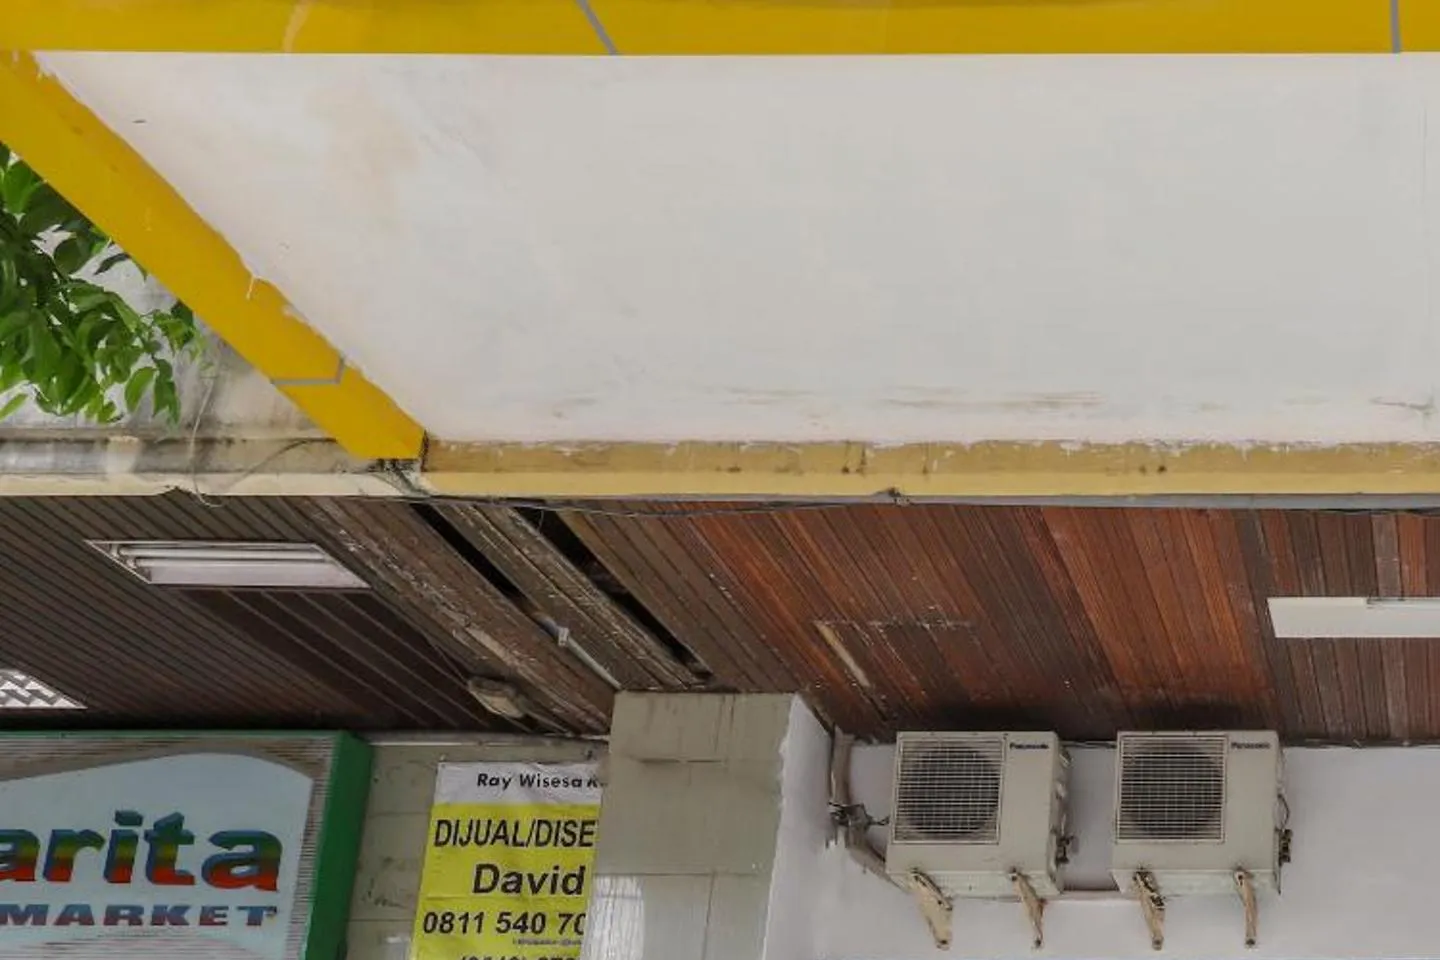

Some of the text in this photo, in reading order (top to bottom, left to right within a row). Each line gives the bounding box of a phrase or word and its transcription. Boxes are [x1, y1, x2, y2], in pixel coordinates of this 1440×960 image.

[478, 773, 511, 790] Ray
[520, 774, 582, 788] Wisesa
[473, 863, 586, 895] David
[0, 903, 277, 927] MARKET
[423, 911, 485, 934] 0811
[496, 911, 546, 935] 540
